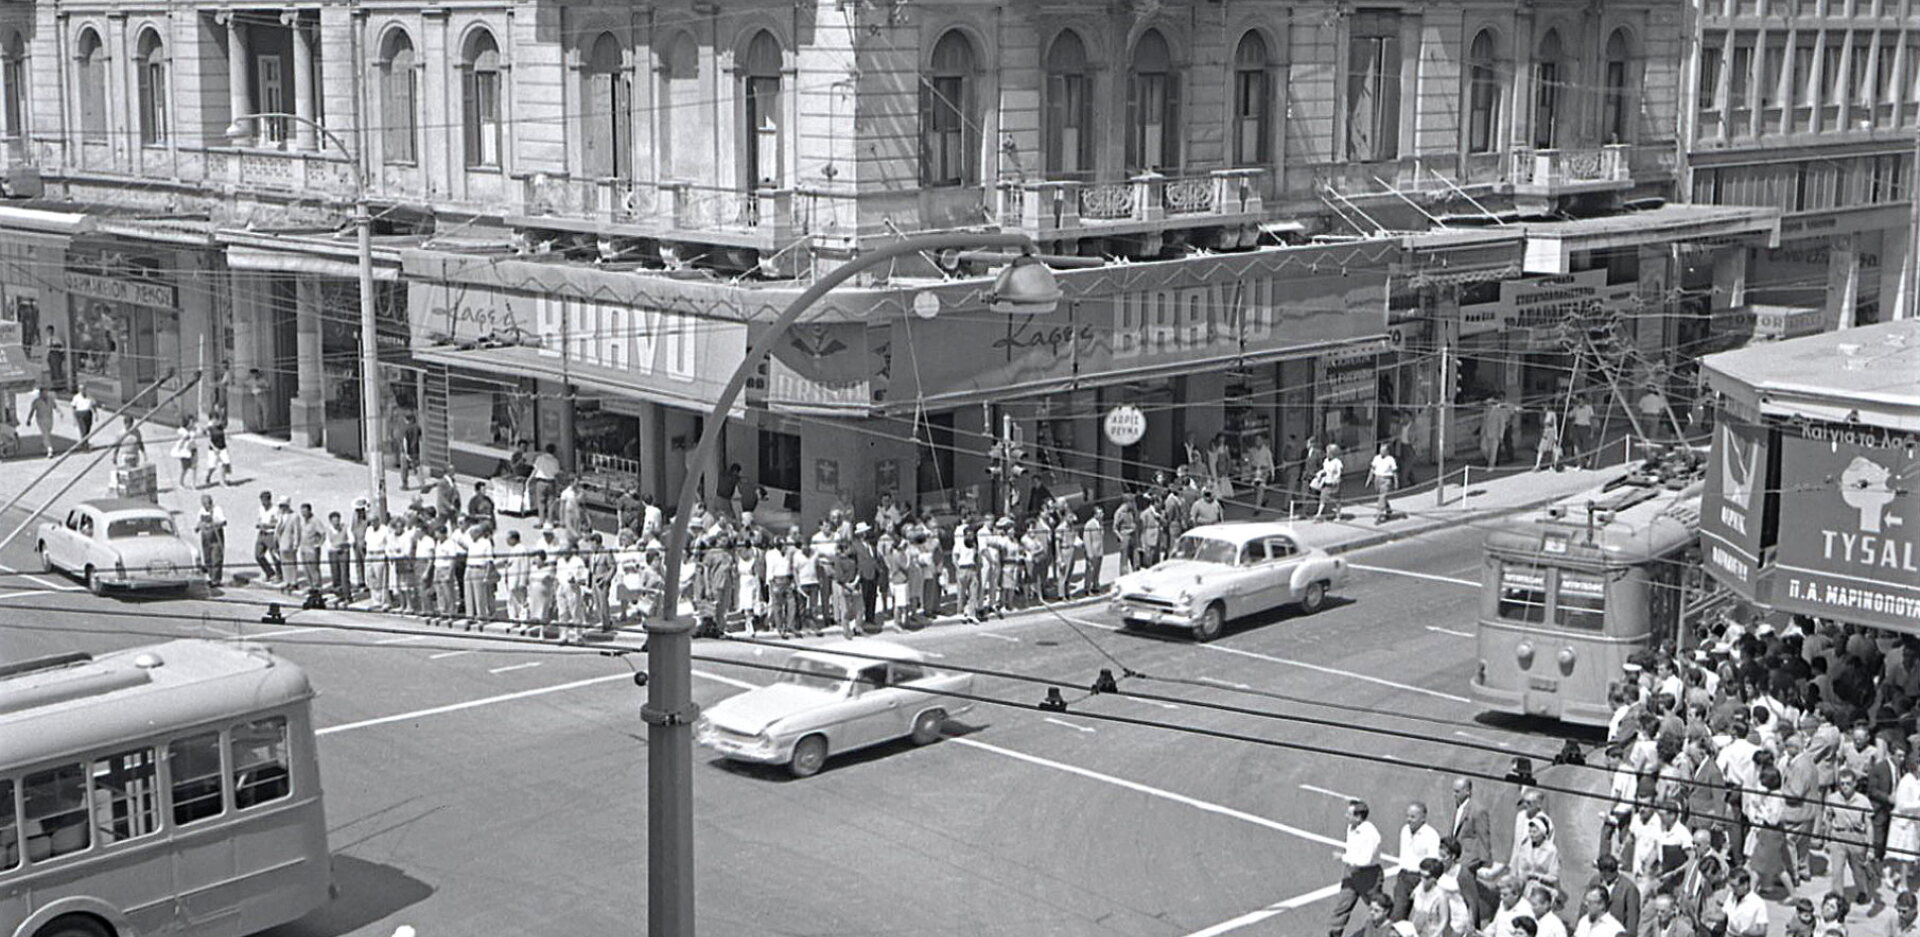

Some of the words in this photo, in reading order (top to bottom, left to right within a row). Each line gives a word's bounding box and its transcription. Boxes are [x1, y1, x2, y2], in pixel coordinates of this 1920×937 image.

[536, 295, 697, 383] BRAVO
[1113, 276, 1273, 360] BRAVO
[1822, 530, 1918, 572] TYSAL
